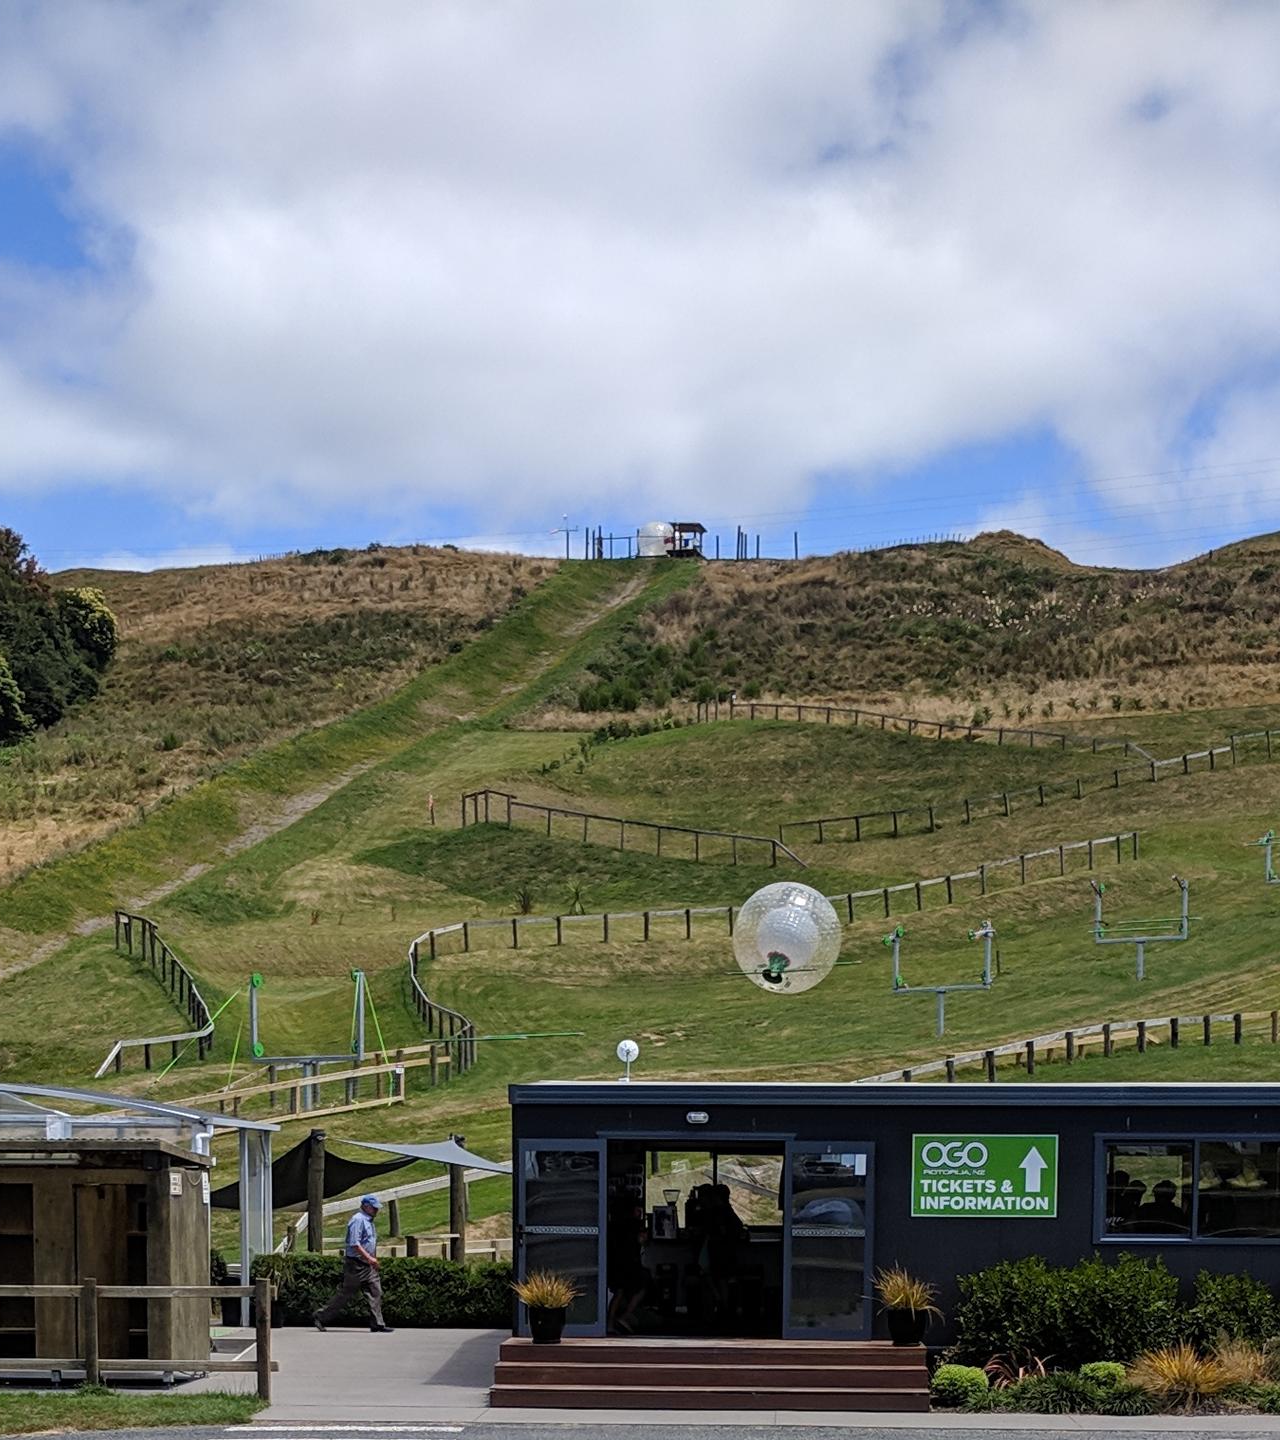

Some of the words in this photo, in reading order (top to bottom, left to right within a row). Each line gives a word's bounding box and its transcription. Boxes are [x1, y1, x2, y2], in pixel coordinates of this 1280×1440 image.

[922, 1141, 988, 1167] OGO
[920, 1179, 996, 1193] TICKETS
[1000, 1179, 1013, 1193] &
[920, 1196, 1049, 1210] INFORMATION
